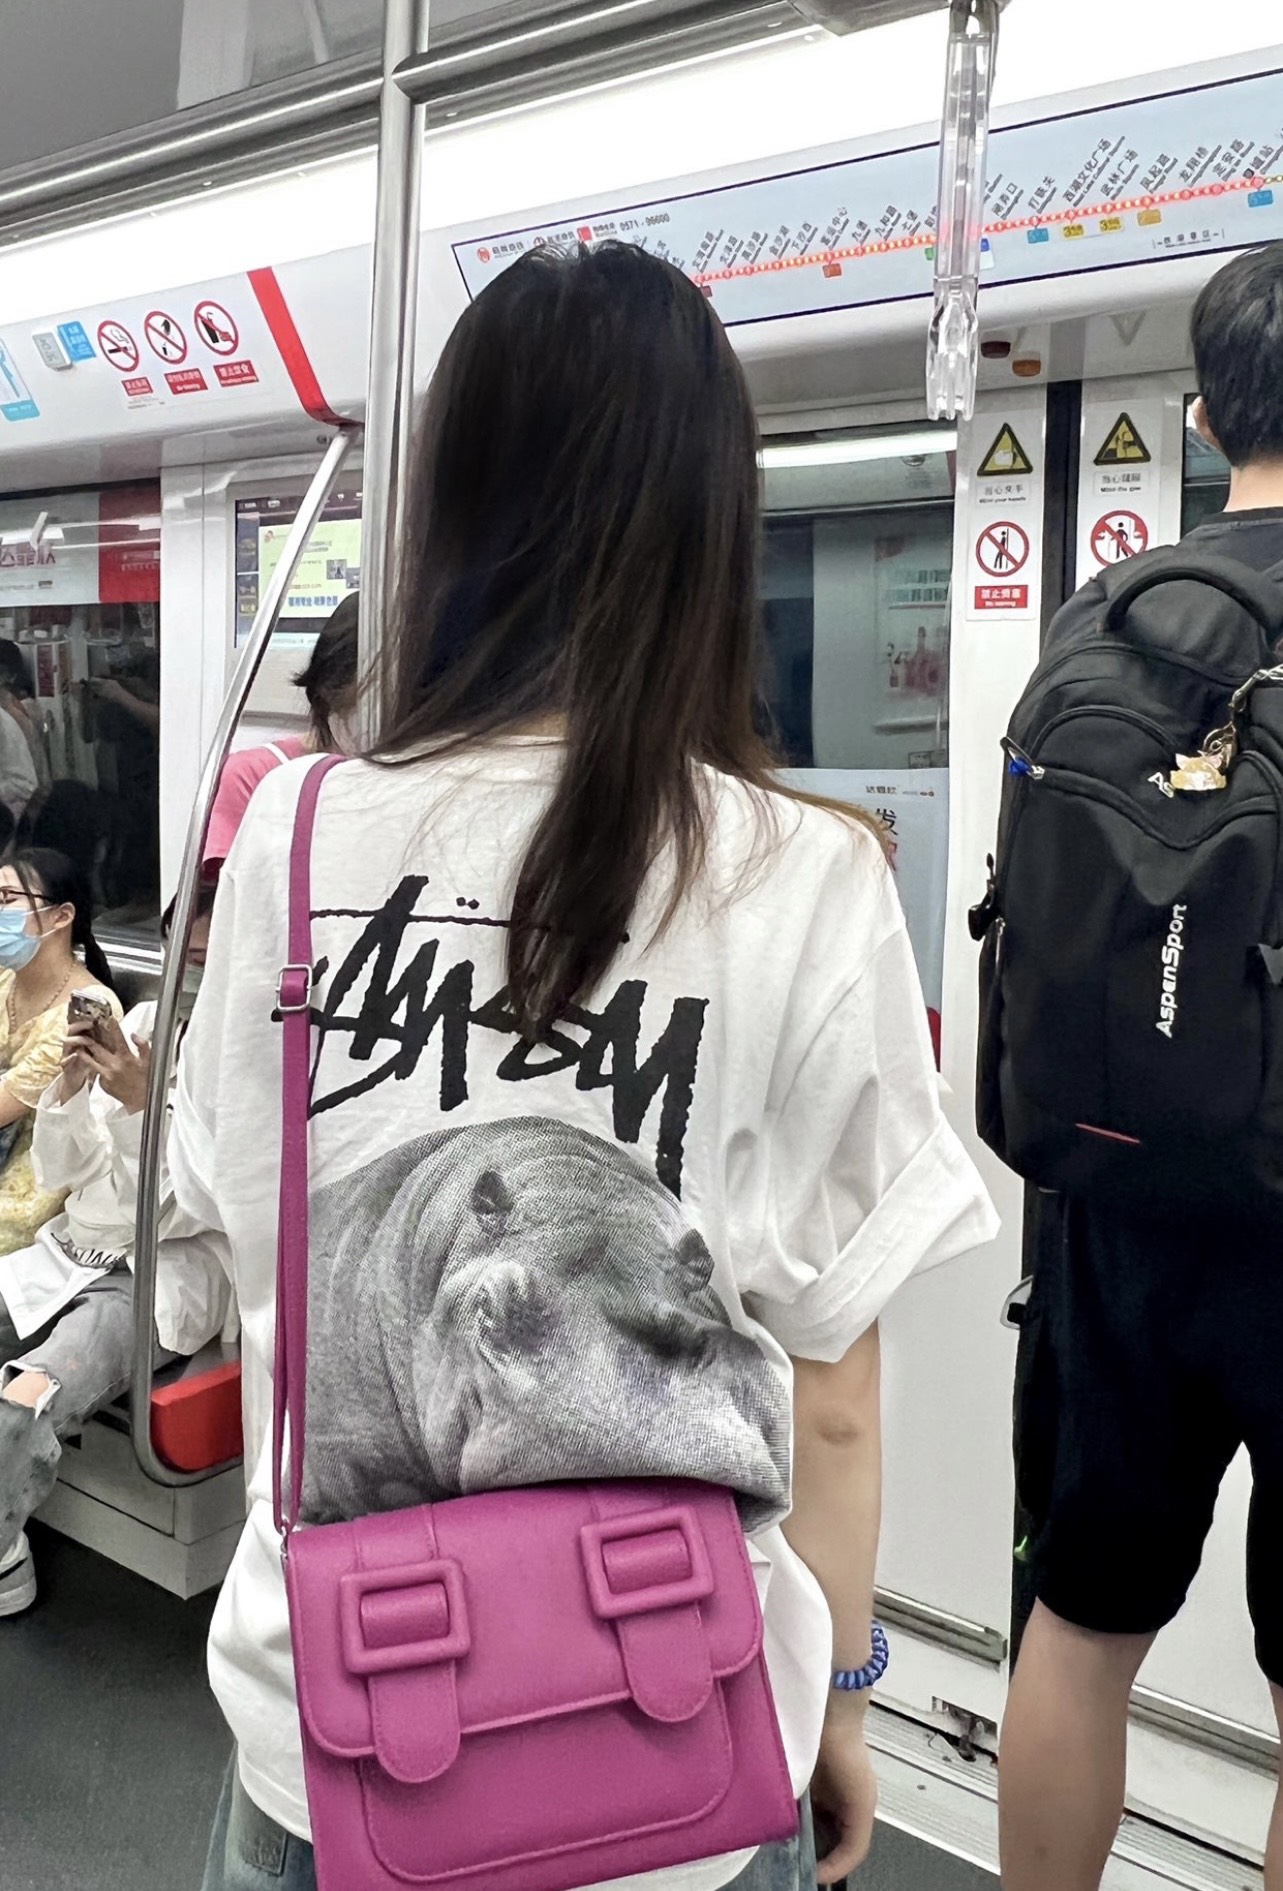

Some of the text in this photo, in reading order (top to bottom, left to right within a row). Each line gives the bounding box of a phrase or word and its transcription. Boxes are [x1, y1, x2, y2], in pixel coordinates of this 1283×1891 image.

[1062, 139, 1111, 203] 西湖文化广场
[1100, 149, 1138, 197] 武林广场
[1140, 153, 1170, 190] 凤起路
[1212, 139, 1244, 177] 定安路
[1028, 176, 1056, 210] 打铁关
[620, 220, 638, 232] 0571
[1155, 903, 1188, 1039] AspenSport
